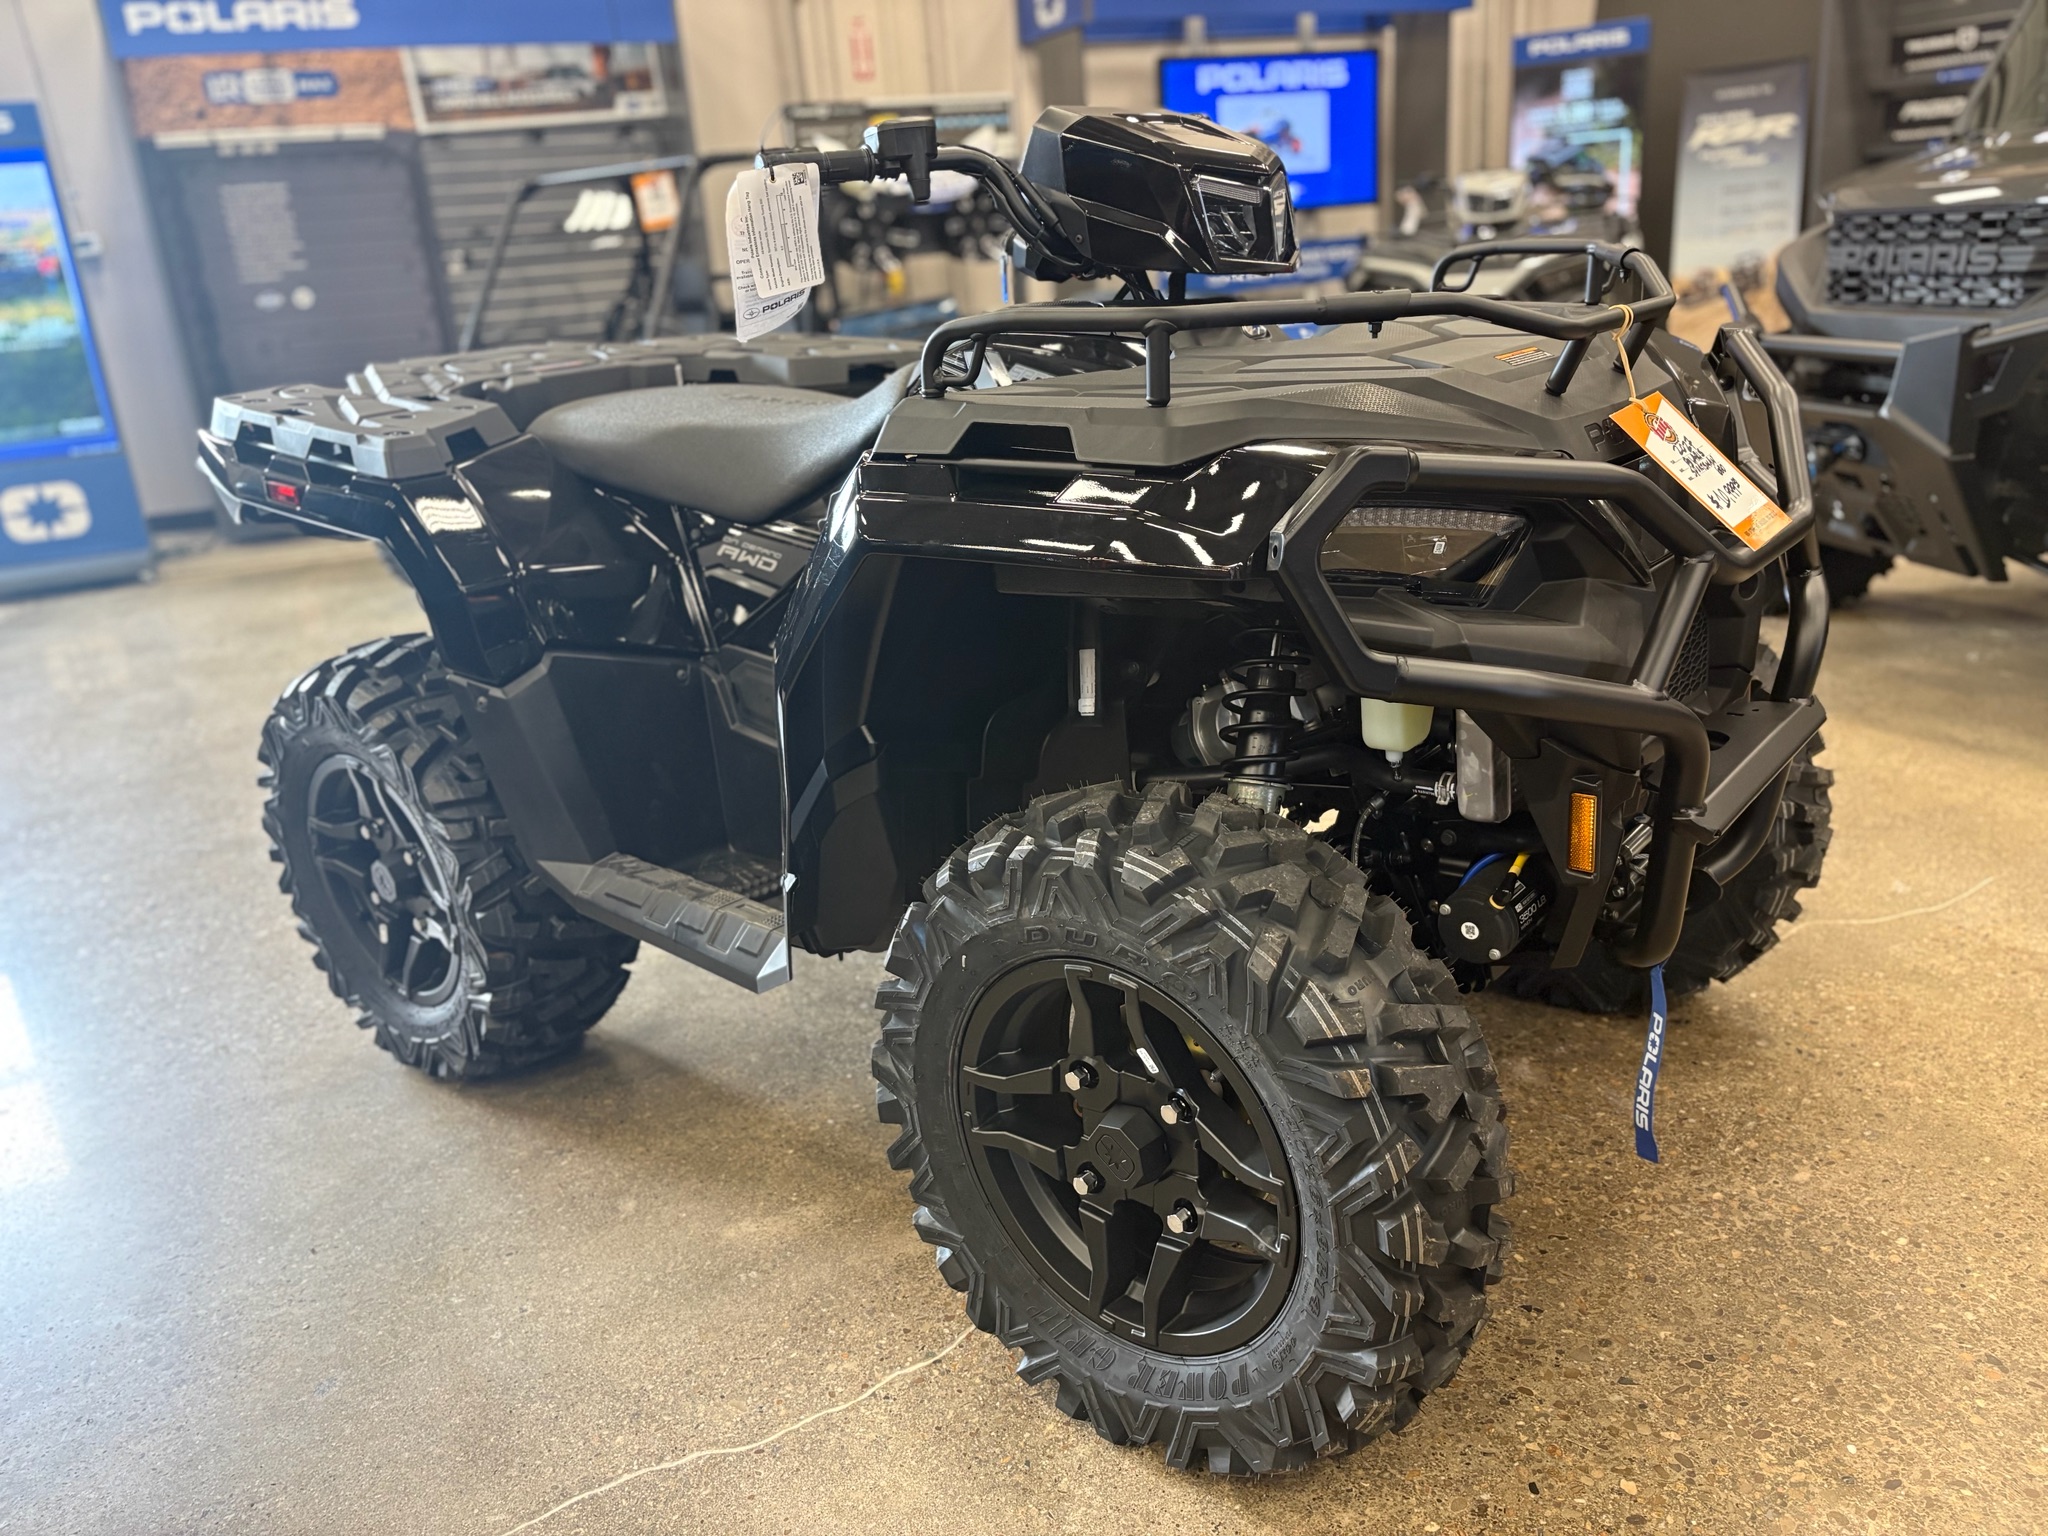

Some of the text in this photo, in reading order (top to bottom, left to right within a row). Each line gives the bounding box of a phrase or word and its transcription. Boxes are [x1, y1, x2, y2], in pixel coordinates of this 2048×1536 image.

[121, 0, 361, 36] POLARIS
[1195, 57, 1349, 95] POLARIS
[1843, 242, 2000, 276] POLARIS
[762, 289, 806, 313] POLARIS
[716, 543, 778, 573] AWD
[1519, 903, 1537, 925] 3500
[1635, 1011, 1664, 1132] POLARIS
